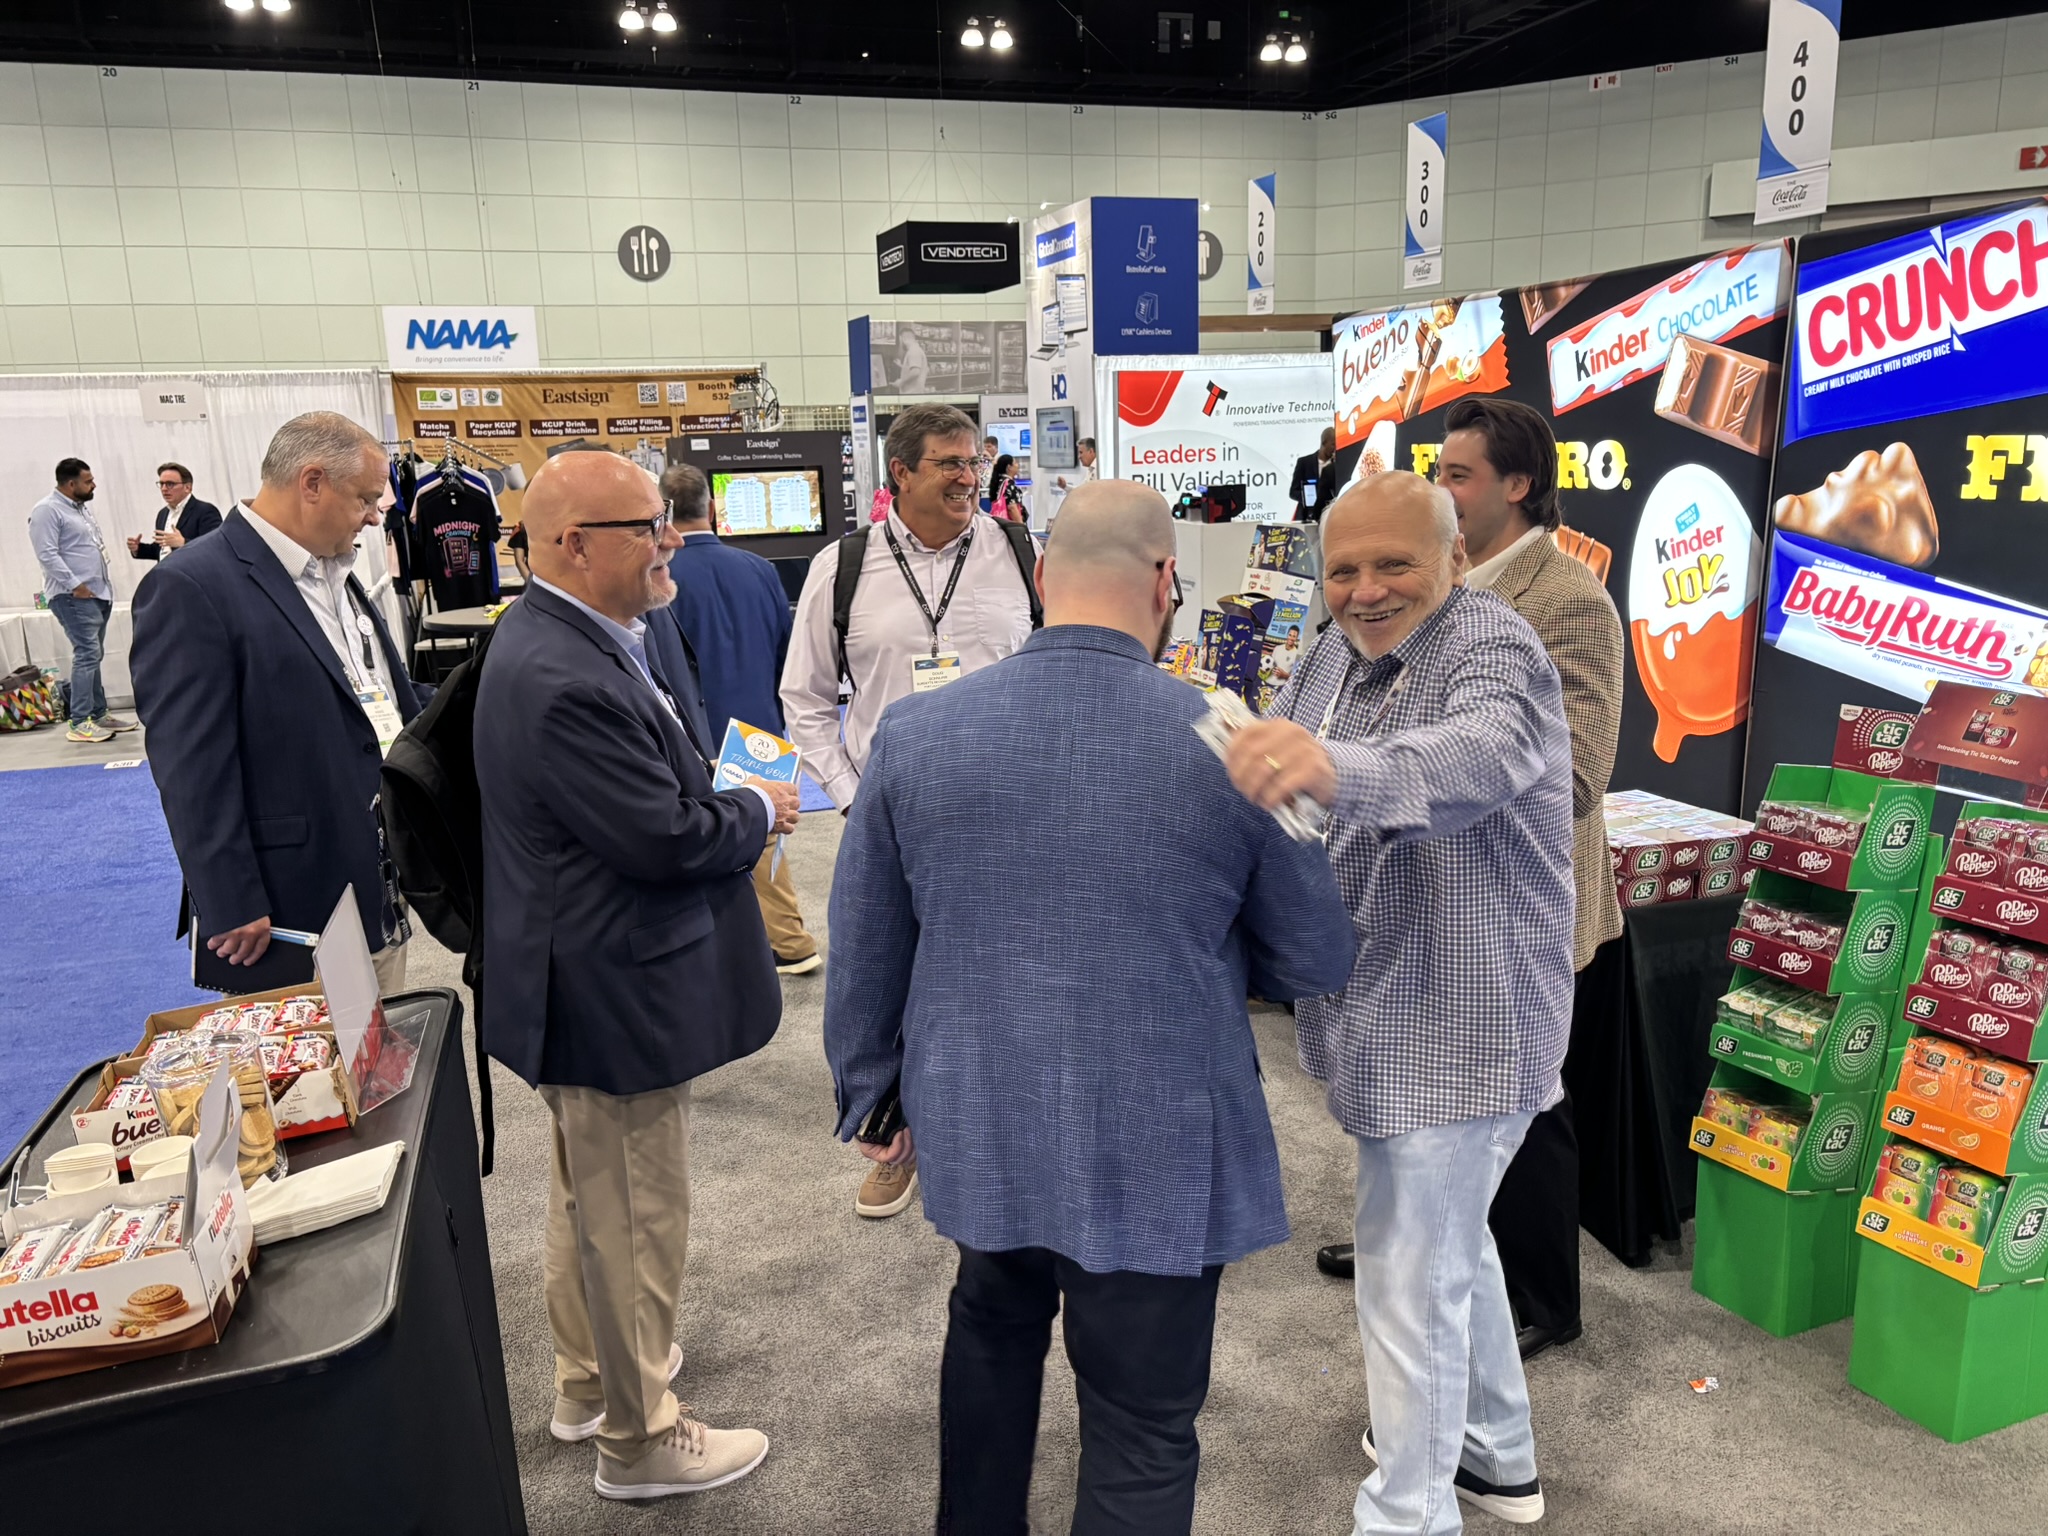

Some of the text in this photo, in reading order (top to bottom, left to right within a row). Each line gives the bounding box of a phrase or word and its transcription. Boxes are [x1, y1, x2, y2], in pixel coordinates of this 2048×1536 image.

[1724, 56, 1739, 66] SH
[102, 67, 117, 77] 20
[1656, 65, 1673, 73] EXIT
[467, 81, 480, 91] 21
[1788, 40, 1810, 136] 400
[789, 96, 802, 105] 22
[1072, 105, 1084, 115] 23
[1325, 111, 1338, 120] SG
[1419, 161, 1430, 228] 300
[1257, 211, 1265, 267] 200
[880, 249, 903, 268] VENDTECH
[927, 246, 1000, 258] VENDTECH
[1808, 218, 2048, 368] CRUNCH
[1352, 315, 1386, 342] Kinder
[1574, 273, 1760, 382] Kinder CHOCOLATE
[406, 319, 518, 350] NAMA
[415, 355, 442, 365] Bringing
[1342, 319, 1409, 395] bueno
[1803, 342, 1951, 398] CREAMY MILK CHOCOLATE WITH CRISPED RICE
[698, 382, 726, 391] Booth
[542, 388, 610, 407] Eastsign
[712, 393, 730, 401] 532
[1000, 408, 1027, 417] LYNK
[1226, 402, 1285, 416] Innovative
[639, 418, 663, 426] Filling
[531, 428, 563, 436] Vending
[746, 439, 779, 449] Eastsign
[1131, 442, 1240, 465] Leaders in
[1171, 468, 1278, 492] Validation
[433, 521, 481, 537] MIDNIGHT
[1655, 525, 1724, 565] Kinder
[1663, 553, 1725, 609] JOY
[1993, 697, 2010, 706] tac
[2000, 693, 2013, 701] tic
[1883, 723, 1904, 736] tic
[1876, 733, 1900, 745] tac
[1881, 750, 1893, 760] Dr
[1937, 743, 1970, 756] Introducing
[1980, 751, 1990, 760] Tac
[1998, 756, 2020, 766] Pepper
[1870, 753, 1901, 770] Pepper
[1893, 821, 1909, 834] tic
[1886, 833, 1908, 846] tac
[1718, 843, 1732, 853] tic
[1645, 853, 1659, 861] tic
[1714, 850, 1731, 860] tac
[1970, 852, 1985, 862] Dr
[1641, 859, 1658, 868] tac
[1959, 853, 1994, 873] Pepper
[1711, 879, 1727, 889] tac
[1715, 873, 1728, 883] tic
[2019, 867, 2048, 888] Peppe
[1635, 889, 1652, 898] tac
[1640, 883, 1652, 891] tic
[1938, 895, 1957, 906] tac
[1944, 889, 1960, 899] tic
[2000, 901, 2035, 921] Pepper
[2012, 900, 2028, 910] Dr
[399, 918, 411, 939] PRIM
[1874, 926, 1891, 939] tic
[1867, 938, 1888, 951] tac
[1934, 965, 1969, 985] Pepper
[1946, 964, 1960, 974] Dr
[1992, 984, 2028, 1004] Pepper
[2004, 983, 2019, 993] Dr
[1971, 1014, 2007, 1034] Pepper
[1982, 1013, 1998, 1024] Dr
[1855, 1026, 1872, 1040] tic
[1718, 1042, 1734, 1052] tac
[1722, 1036, 1734, 1046] tic
[1848, 1038, 1869, 1050] tac
[1914, 1069, 1939, 1081] ORANGE
[1972, 1090, 1998, 1103] ORANGE
[126, 1107, 157, 1120] Kind
[1896, 1106, 1912, 1116] tic
[1890, 1112, 1909, 1125] tac
[112, 1118, 161, 1147] bue
[1832, 1126, 1850, 1139] tic
[1921, 1122, 1946, 1133] ORANGE
[1696, 1136, 1711, 1146] tac
[1701, 1130, 1712, 1139] tic
[1825, 1137, 1846, 1150] tac
[207, 1191, 234, 1243] nutella
[2026, 1210, 2042, 1225] tic
[2017, 1224, 2039, 1237] tac
[1893, 1232, 1928, 1247] ADVENTURE
[0, 1288, 99, 1330] utella
[27, 1313, 103, 1348] biscuits
